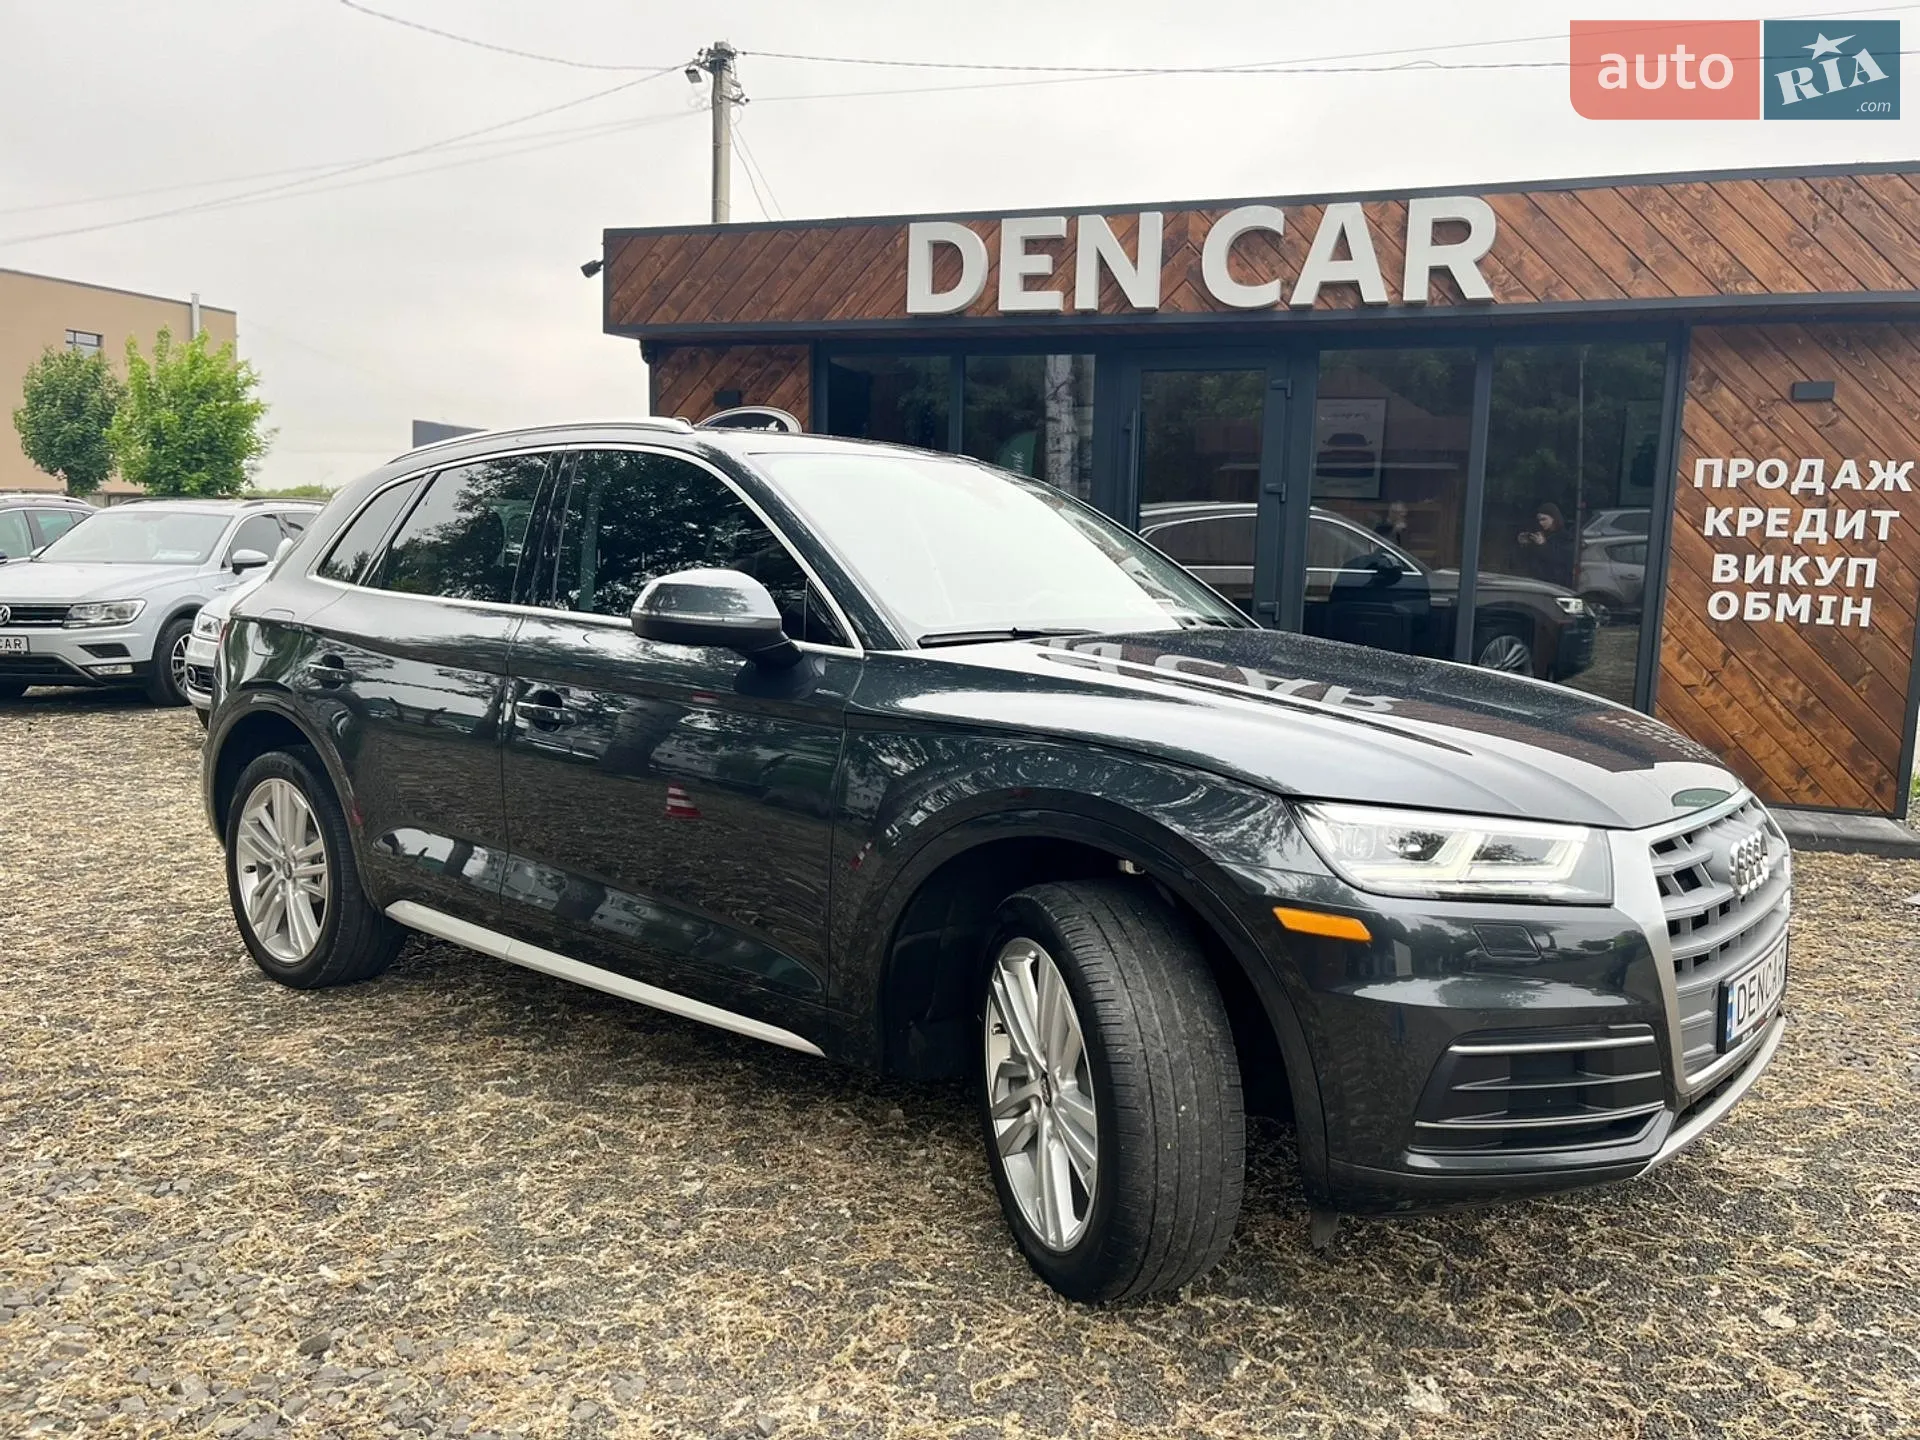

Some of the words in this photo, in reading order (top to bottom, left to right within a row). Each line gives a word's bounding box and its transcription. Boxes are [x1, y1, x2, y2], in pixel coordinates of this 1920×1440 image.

[906, 211, 1164, 315] DEN
[1201, 195, 1497, 309] CAR
[1693, 458, 1914, 496] ПРОДАЖ
[1704, 506, 1900, 545] КРЕДИТ
[1712, 554, 1877, 588] ВИКУП
[1707, 591, 1872, 628] ОБМІН
[1737, 946, 1784, 1026] DENCAR
